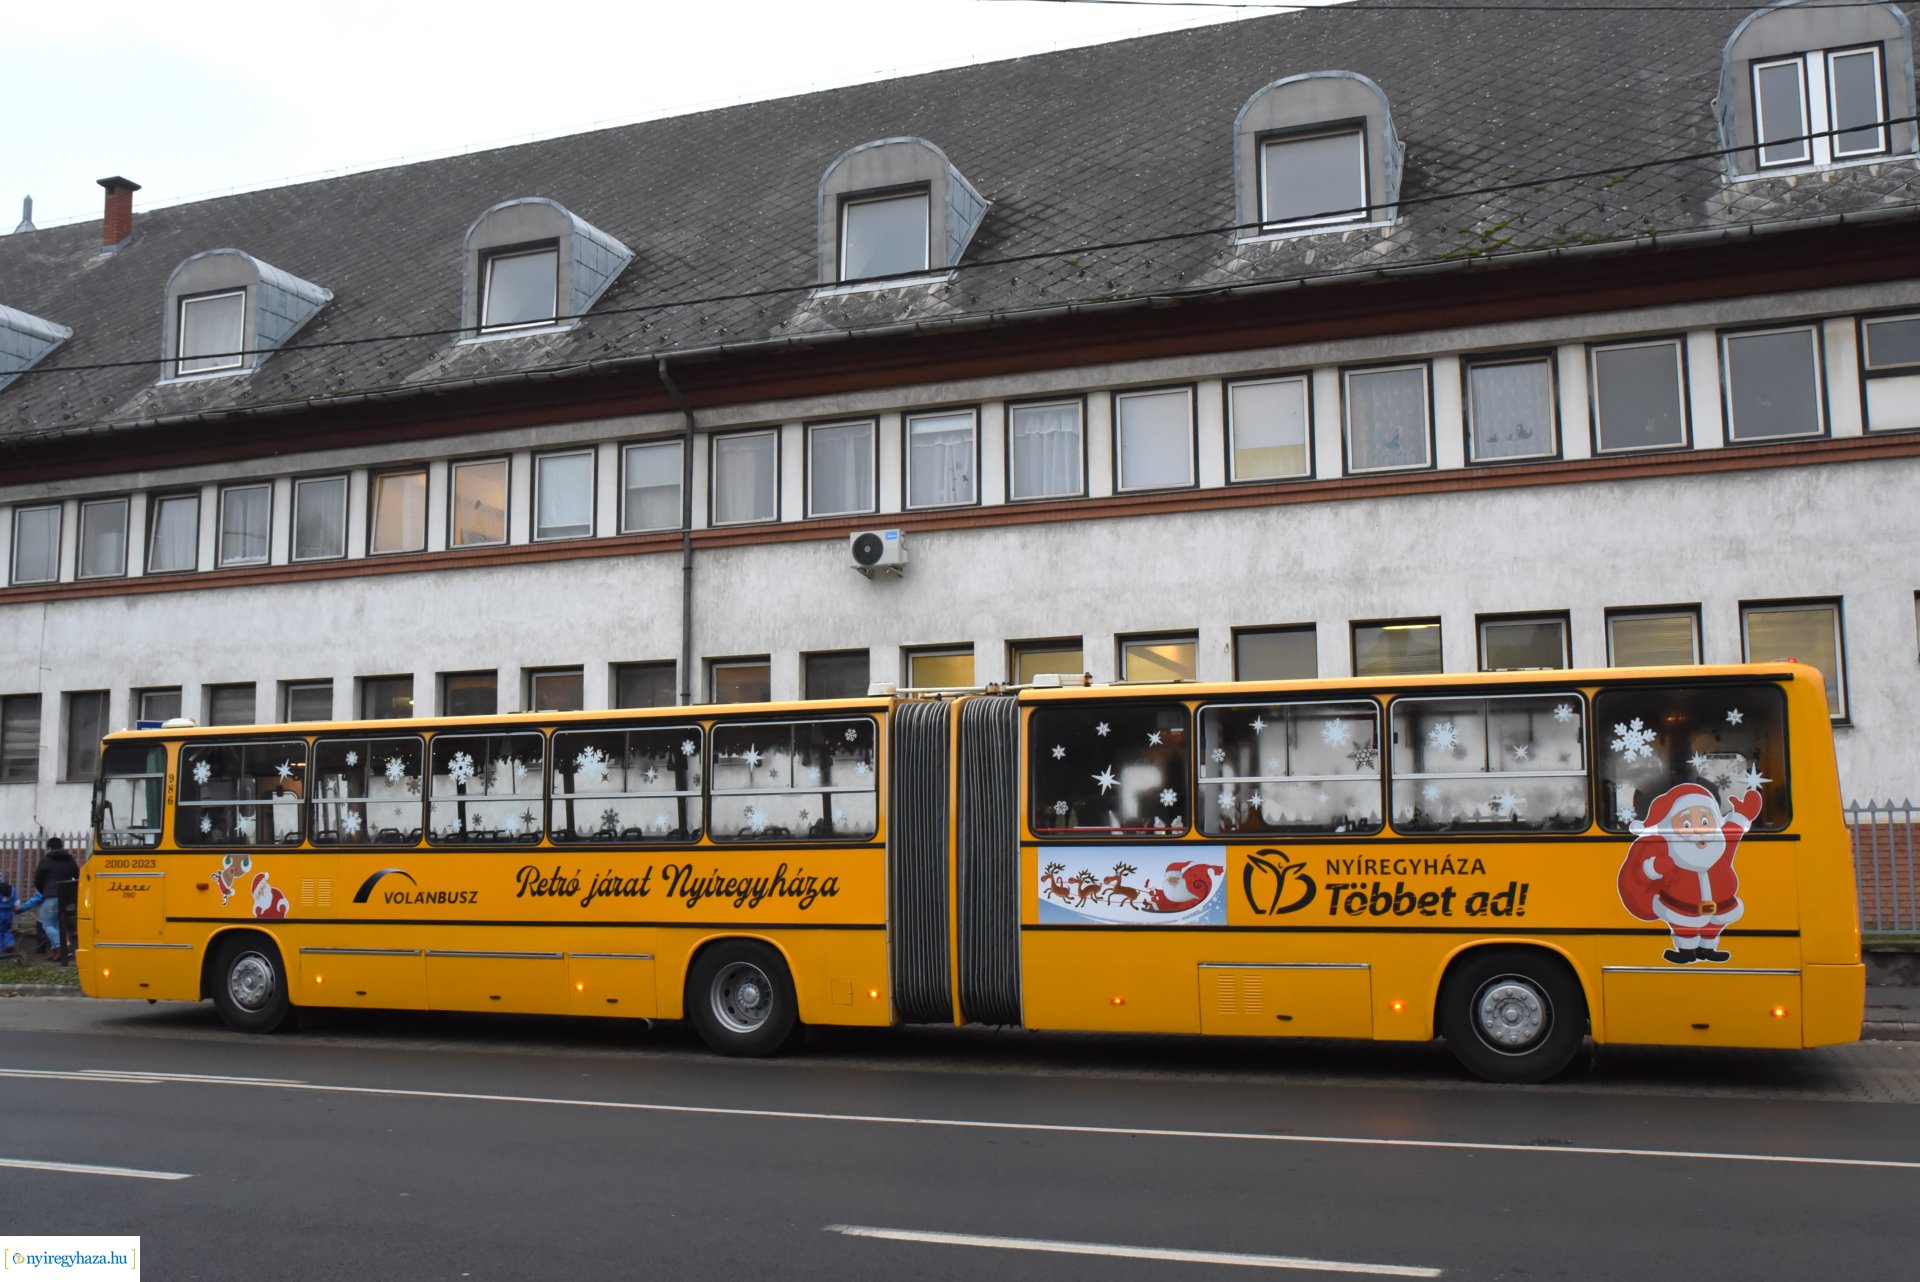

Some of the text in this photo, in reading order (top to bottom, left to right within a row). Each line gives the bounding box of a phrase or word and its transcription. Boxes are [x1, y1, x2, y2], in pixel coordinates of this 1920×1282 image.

[167, 773, 175, 805] 986
[1326, 853, 1486, 876] NYÍREGYHÁZA
[384, 891, 478, 905] VOLÁNBUSZ
[516, 862, 839, 911] Retró járat Nyíregyháza
[1326, 881, 1529, 917] Többet ad!
